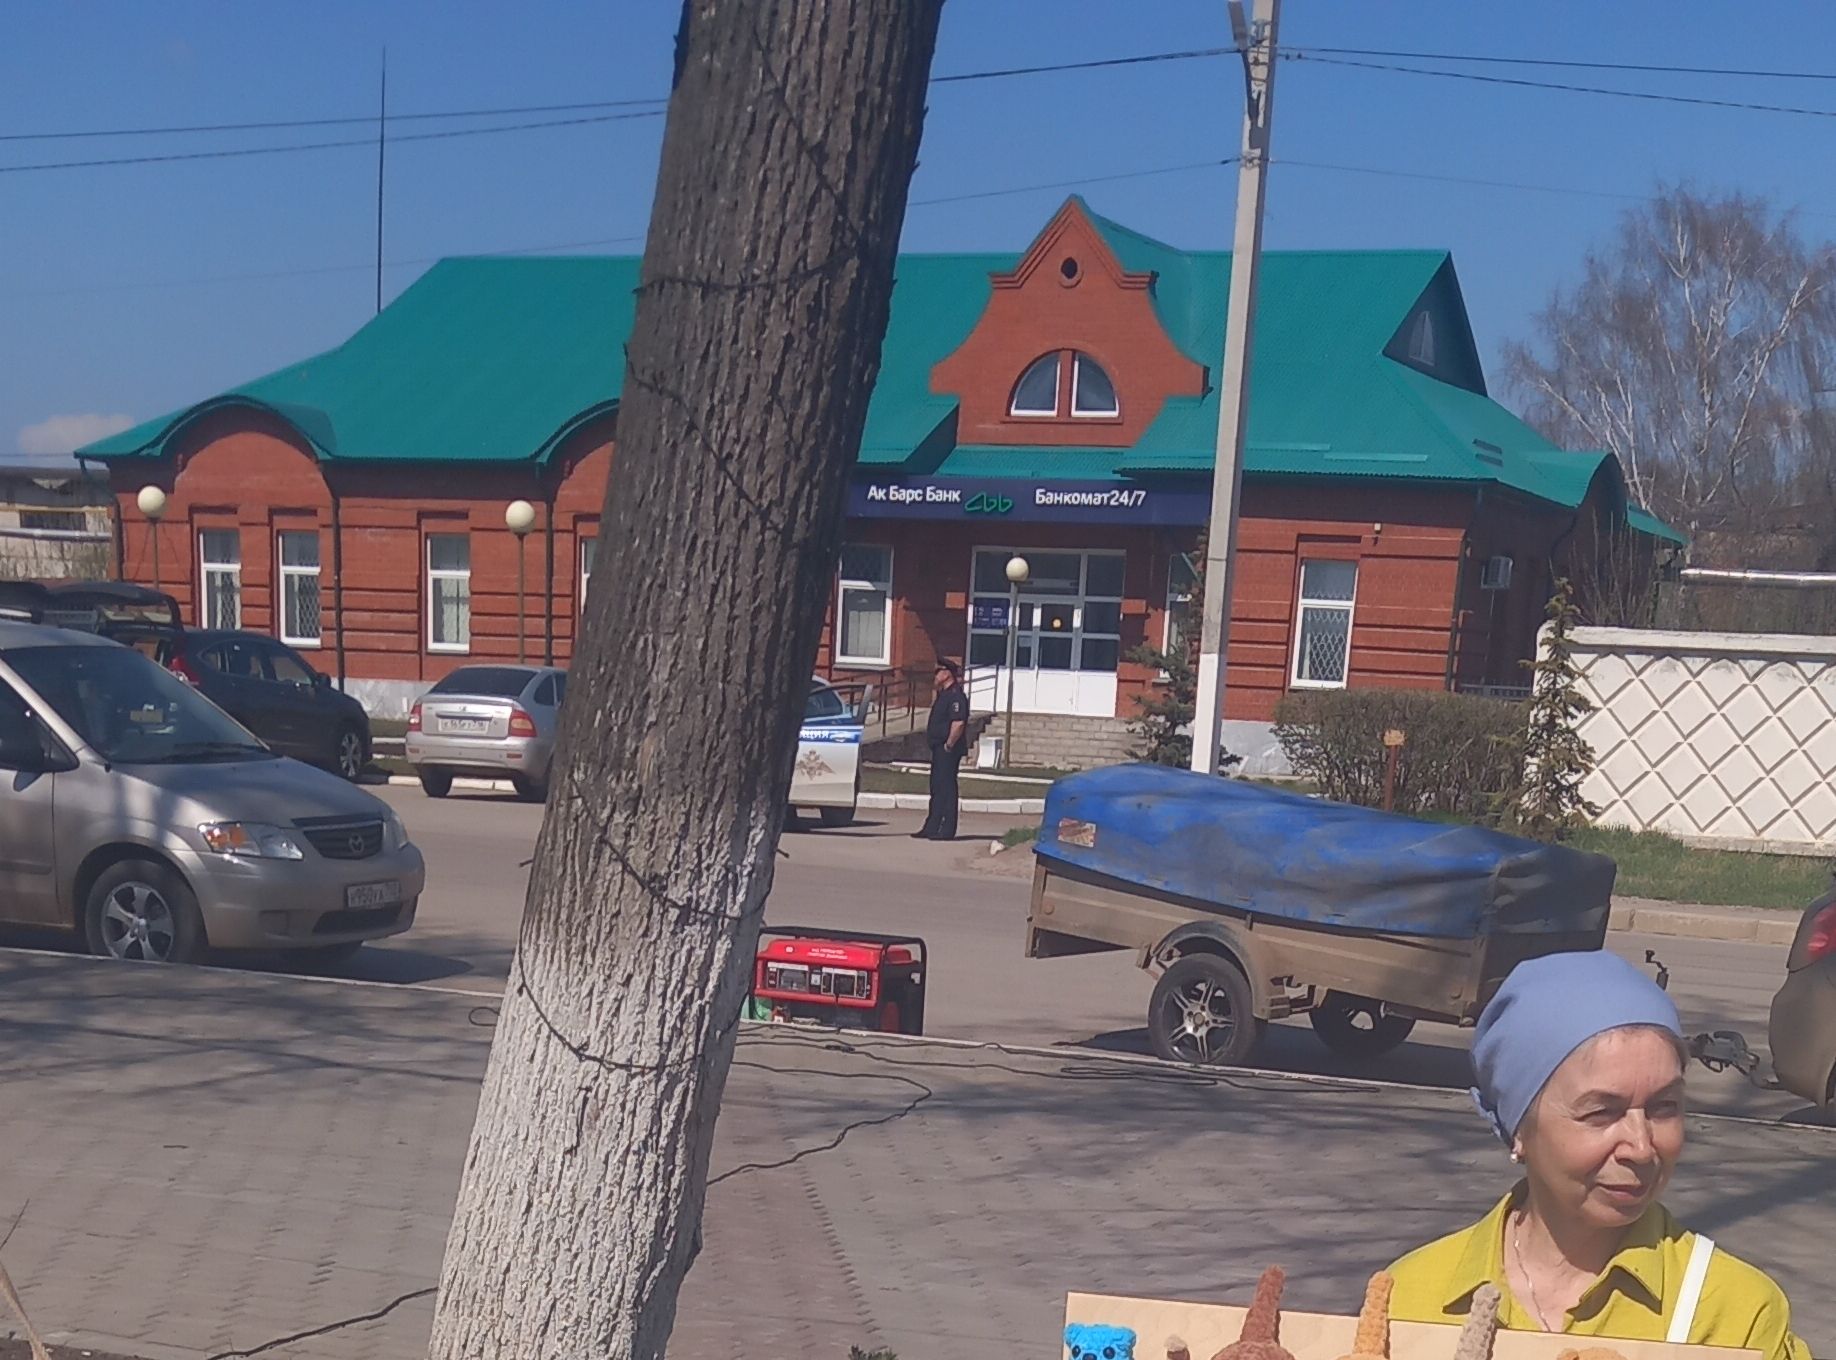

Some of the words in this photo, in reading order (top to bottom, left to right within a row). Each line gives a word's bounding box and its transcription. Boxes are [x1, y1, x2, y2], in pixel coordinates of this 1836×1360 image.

[867, 485, 887, 500] Ак
[889, 485, 923, 504] Барс
[926, 486, 962, 503] Банк
